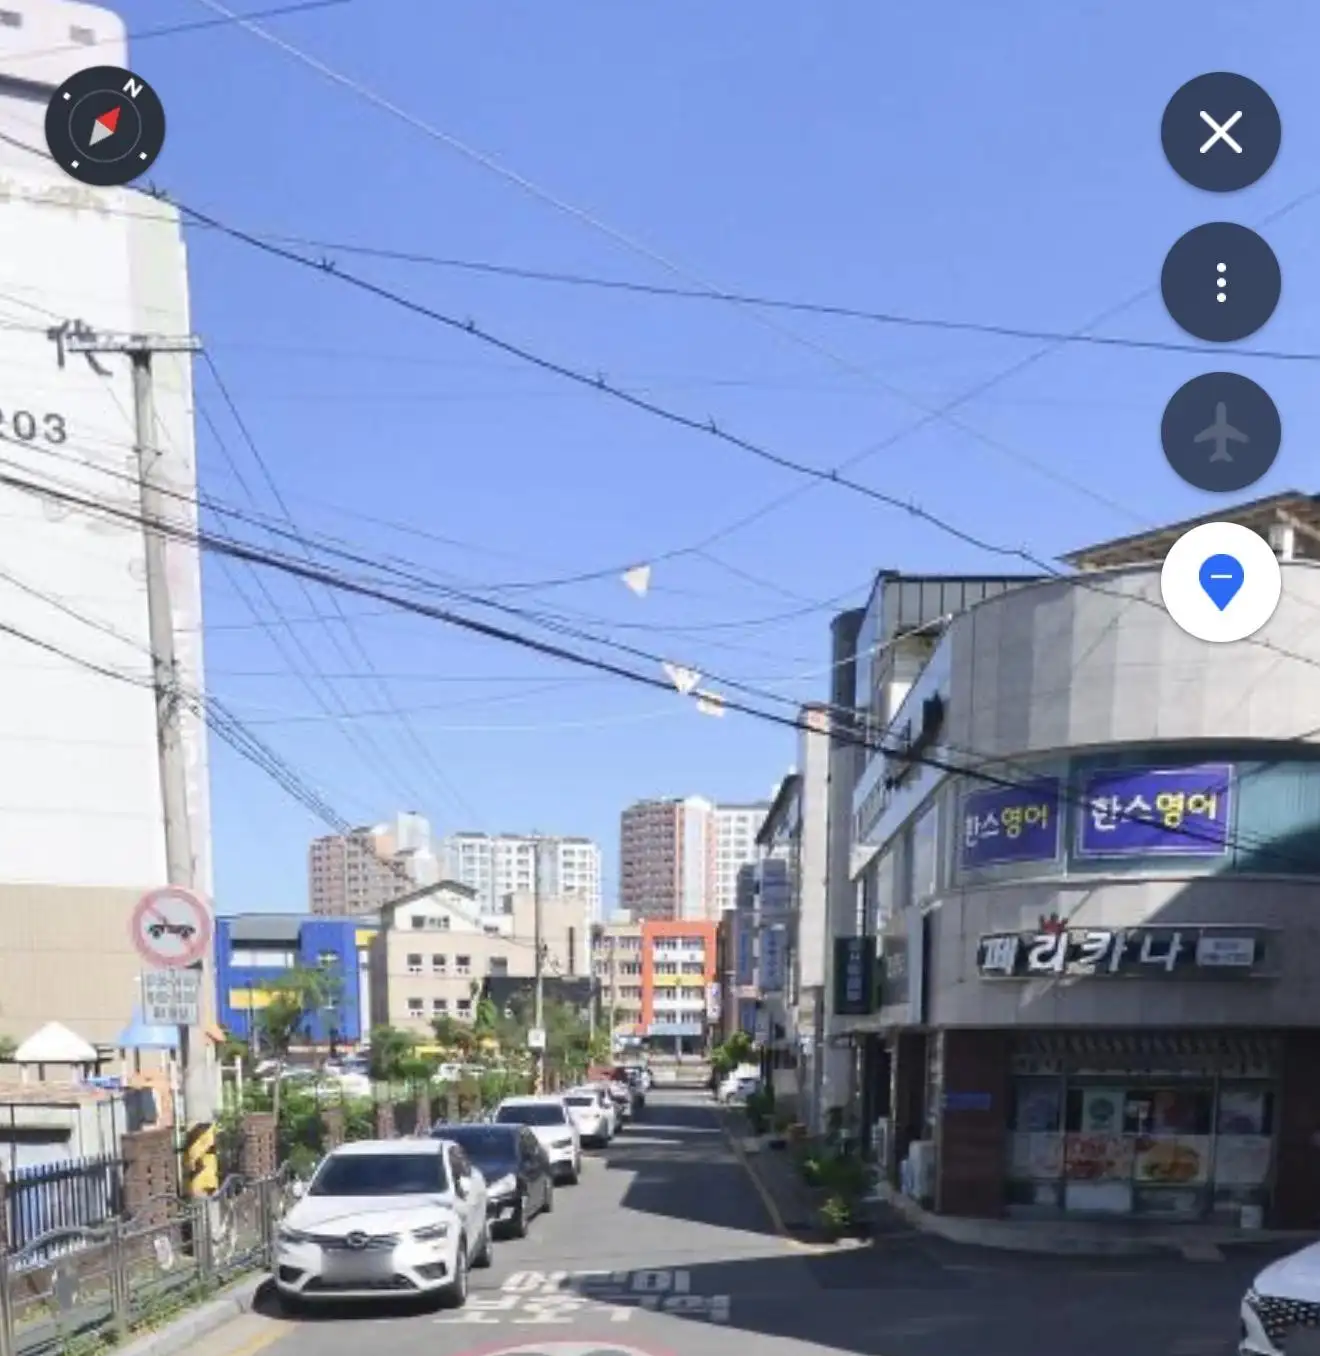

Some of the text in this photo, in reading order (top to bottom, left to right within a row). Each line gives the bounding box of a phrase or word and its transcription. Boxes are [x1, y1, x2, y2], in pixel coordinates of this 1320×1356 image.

[0, 408, 66, 444] 03
[965, 804, 1048, 848] 한스영어
[1091, 792, 1217, 831] 한스영어
[981, 931, 1182, 975] 페리카나
